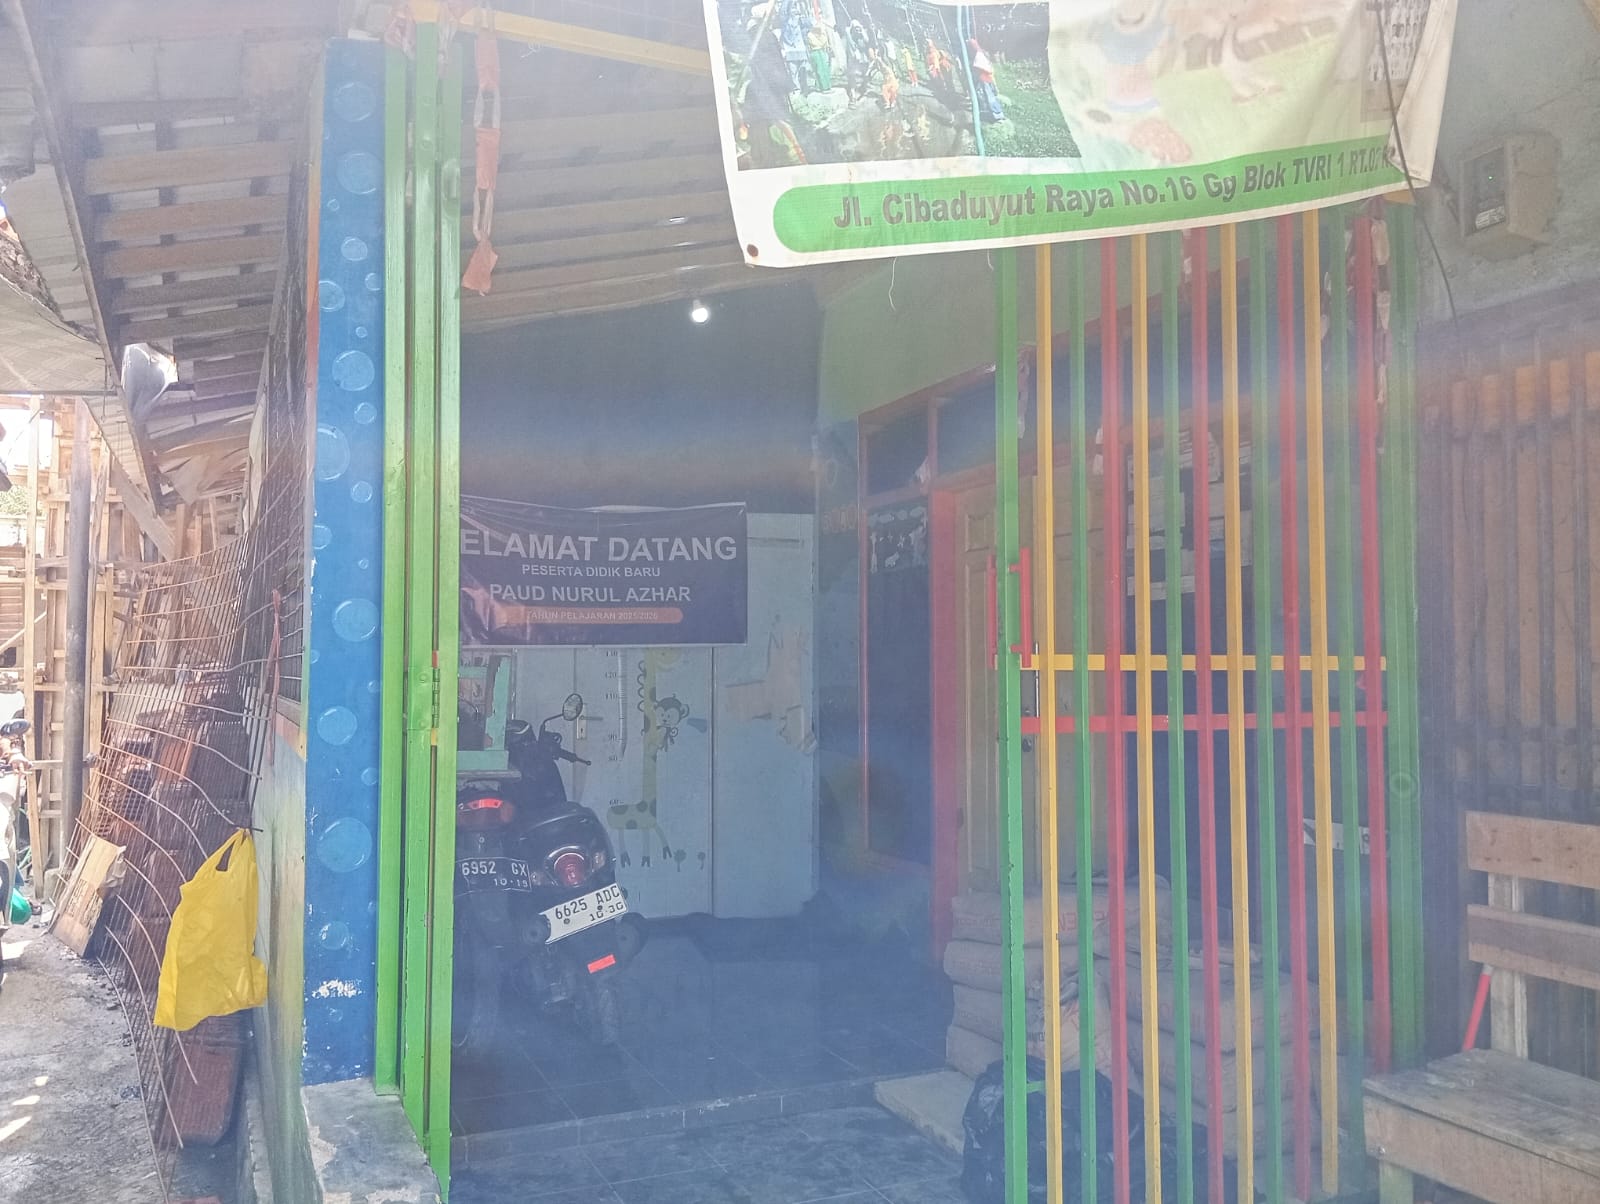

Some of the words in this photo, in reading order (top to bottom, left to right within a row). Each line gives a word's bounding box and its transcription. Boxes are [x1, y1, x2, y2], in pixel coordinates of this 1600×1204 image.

[833, 195, 872, 228] Jl.
[882, 185, 1036, 226] Cibaduyut
[1045, 184, 1115, 218] Raya
[1118, 175, 1197, 206] No.16
[1203, 173, 1237, 203] Gg
[1243, 164, 1287, 193] Blok
[1293, 154, 1332, 185] TVRI
[1337, 152, 1345, 178] 1
[459, 528, 598, 562] ELAMAT
[607, 535, 738, 562] DATANG
[522, 564, 584, 577] PESERTA
[586, 566, 621, 578] DIDIK
[624, 567, 661, 578] BARU
[489, 583, 545, 601] PAUD
[551, 586, 620, 602] NURUL
[626, 586, 692, 602] AZHAR
[527, 610, 558, 620] TAHUN
[560, 611, 616, 621] PELAJARAN
[461, 860, 497, 876] 6952
[511, 862, 528, 877] GX
[555, 898, 588, 920] 6625
[595, 885, 620, 905] ADC
